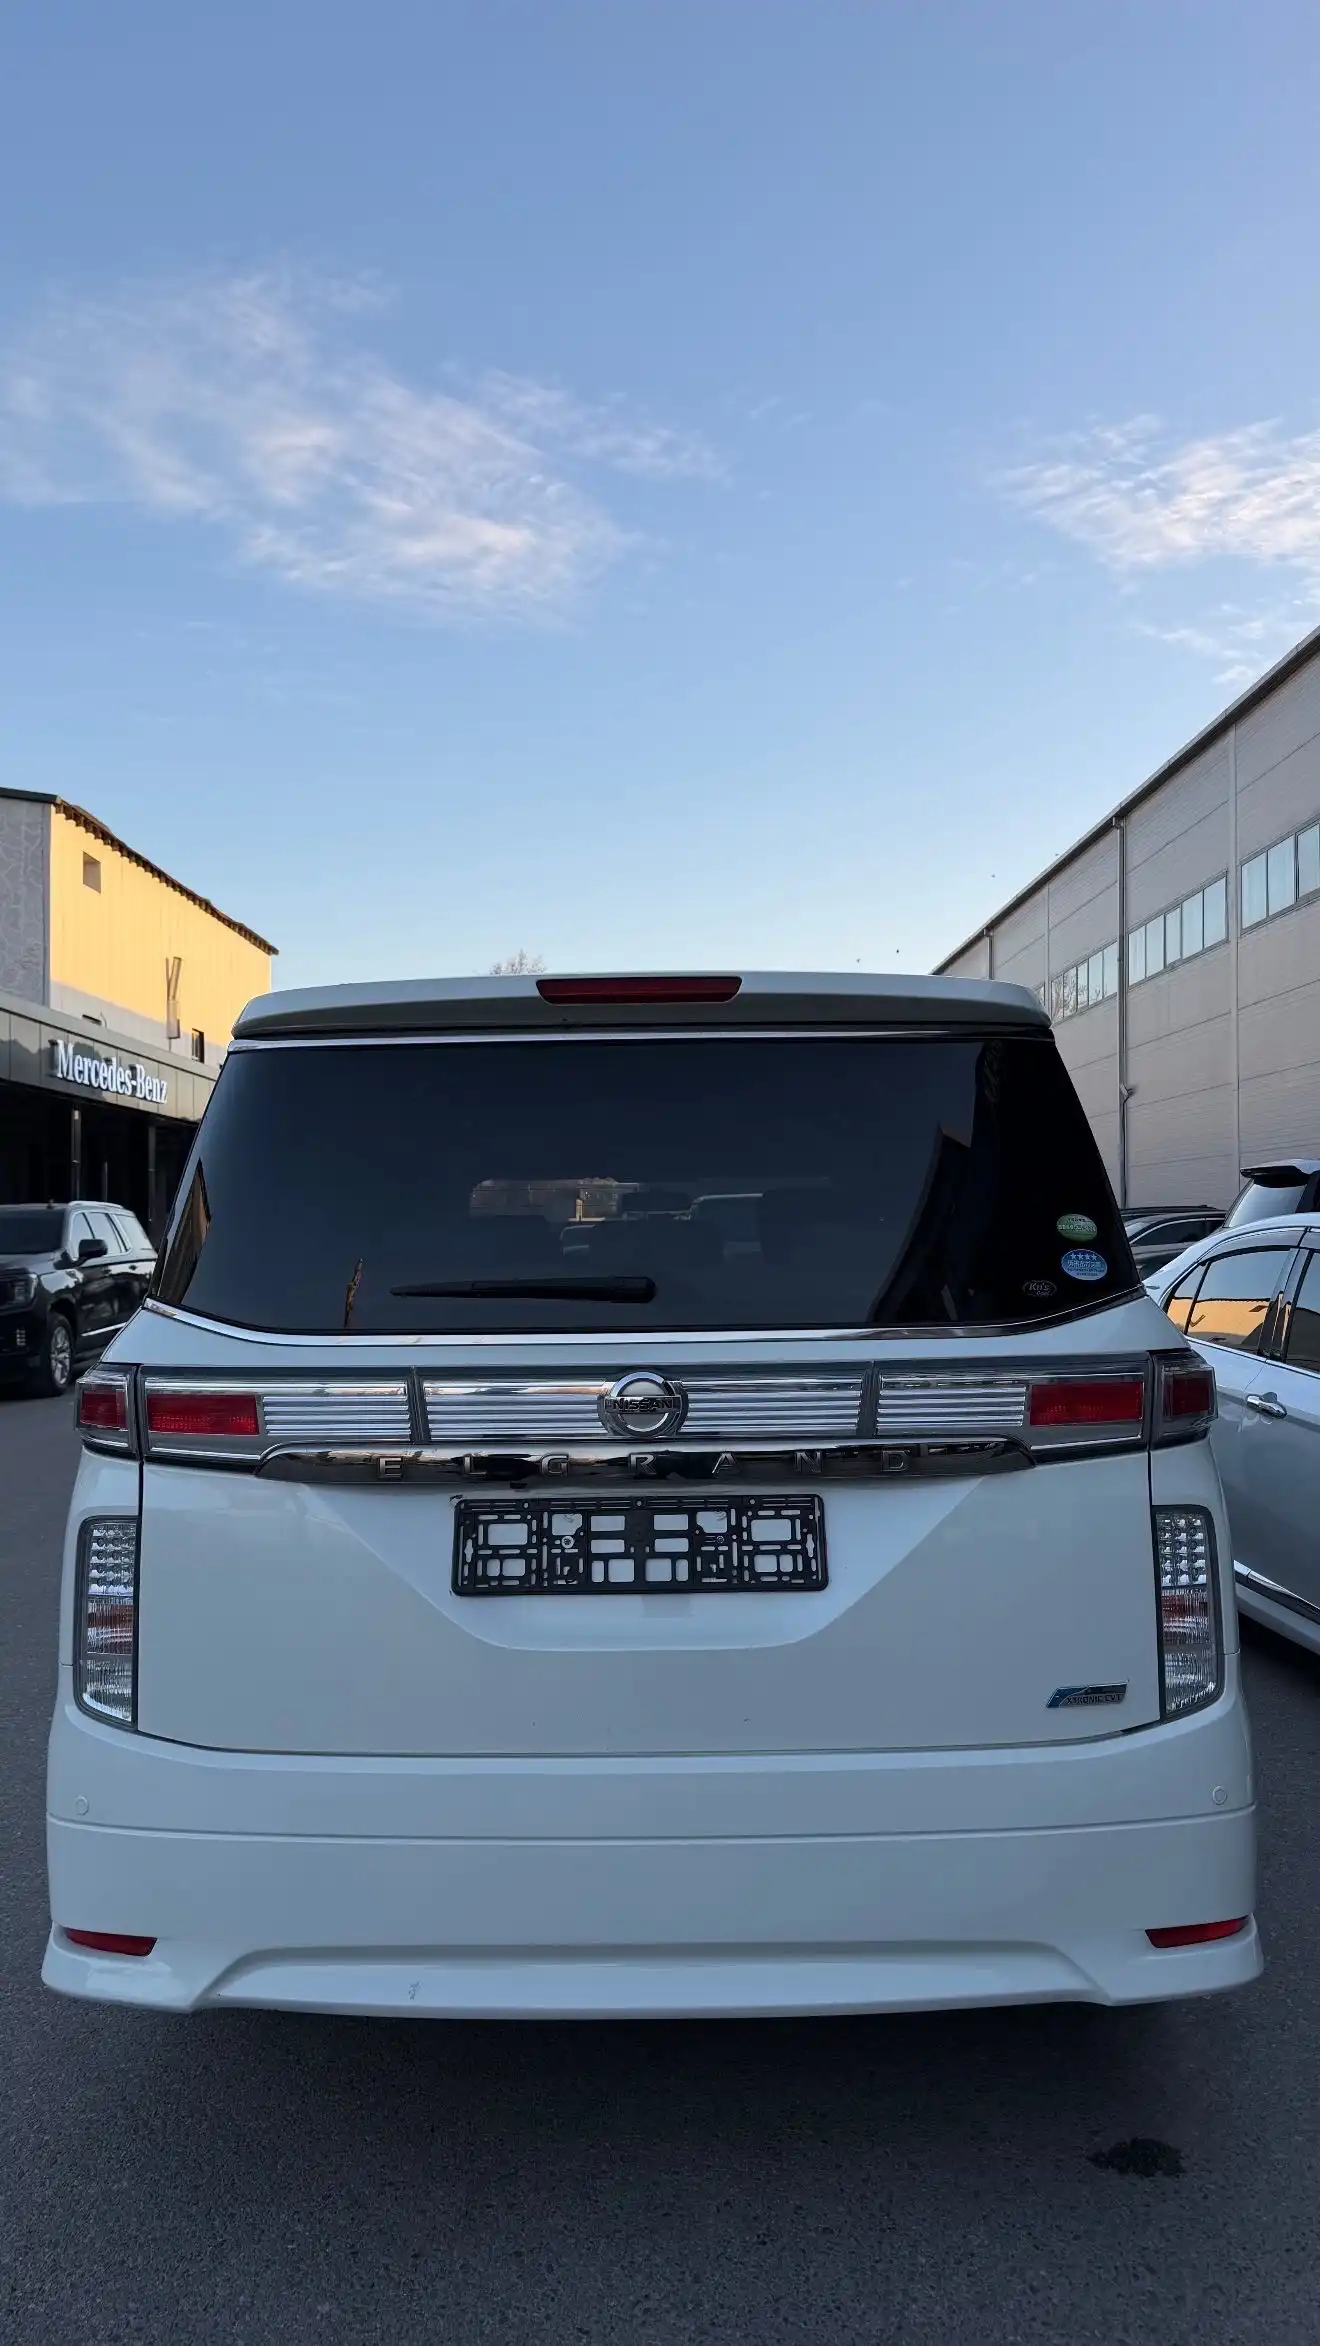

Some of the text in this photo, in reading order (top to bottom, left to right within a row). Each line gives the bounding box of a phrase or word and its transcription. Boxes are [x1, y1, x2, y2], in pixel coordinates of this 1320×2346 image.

[56, 1039, 168, 1104] Mercedes-Benz
[613, 1397, 673, 1411] NISSAN
[377, 1450, 912, 1477] ELGRAND
[1066, 1694, 1122, 1705] XTRONIC CVT
